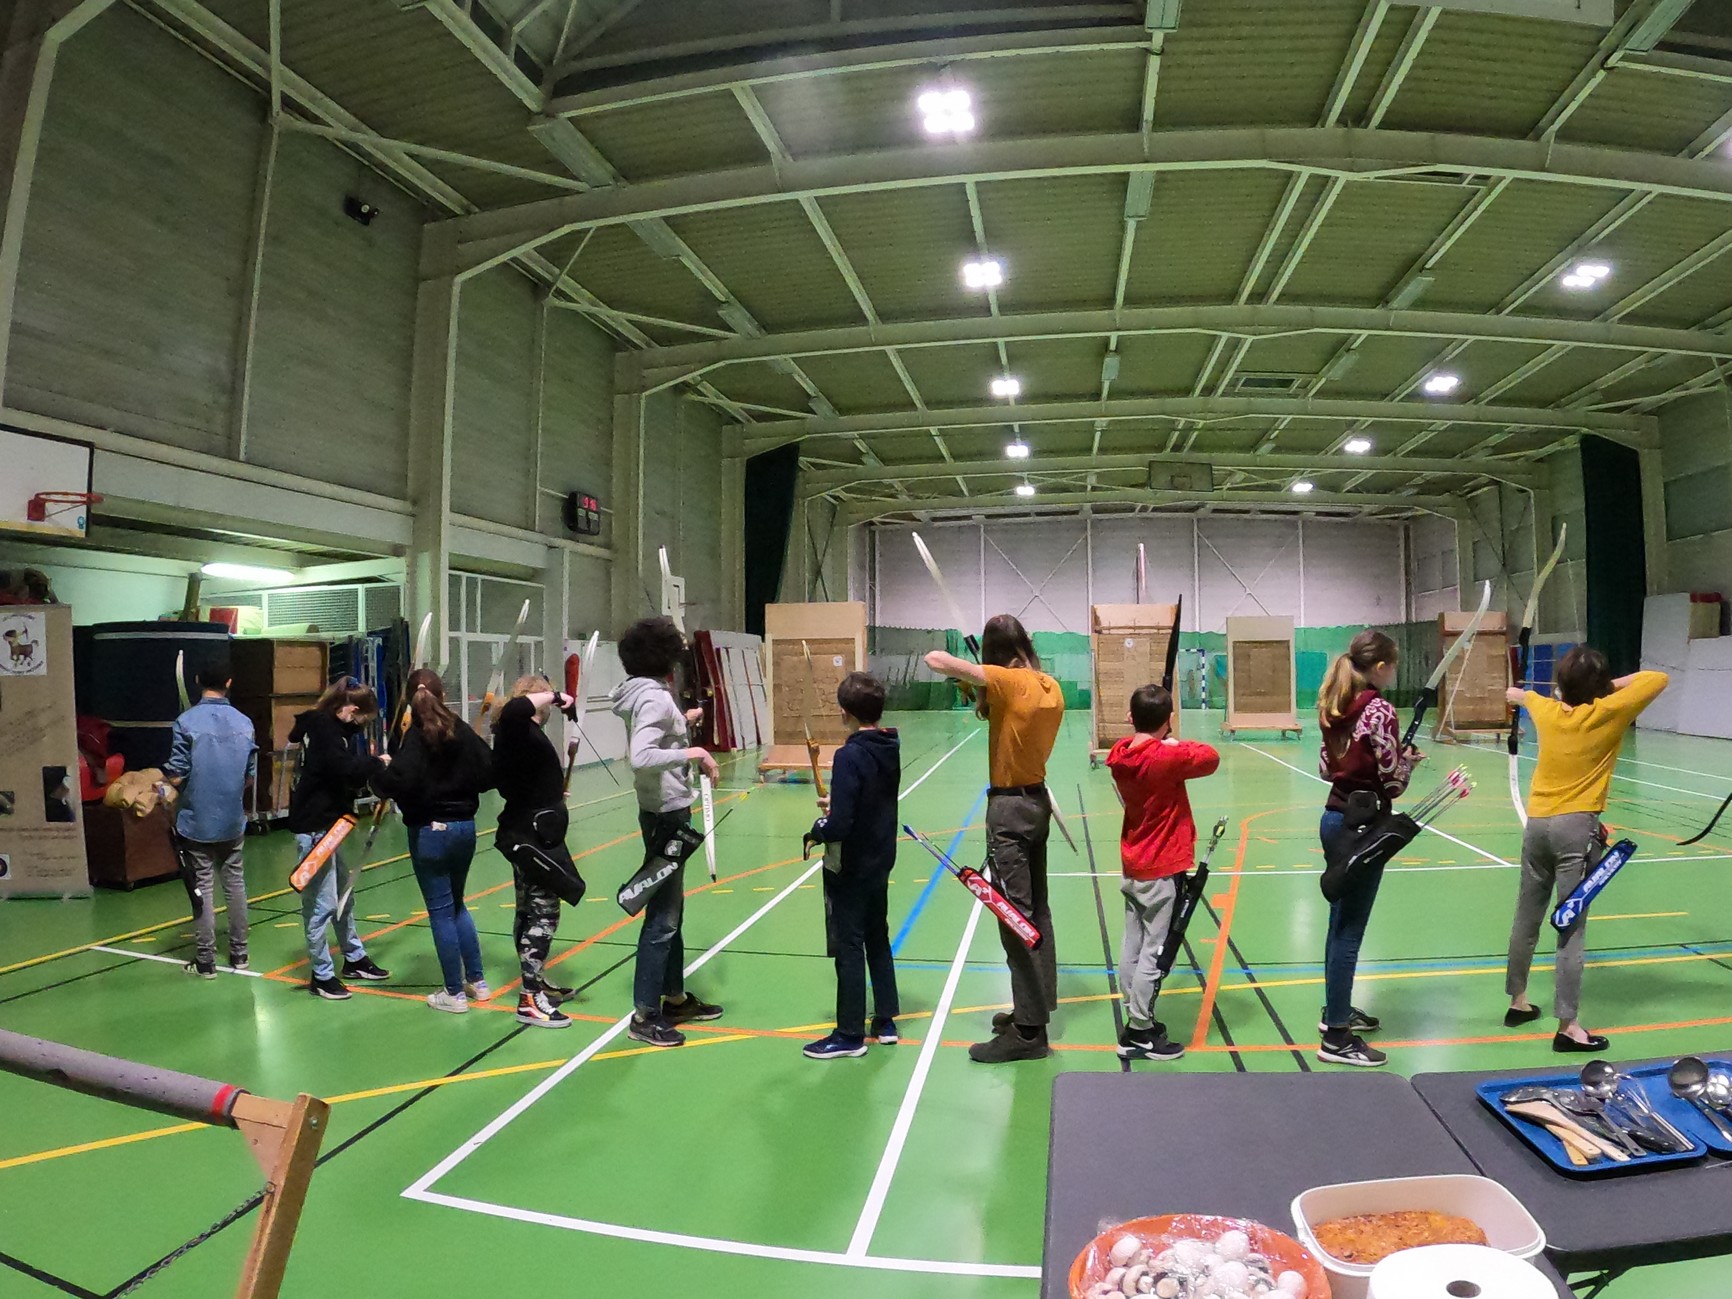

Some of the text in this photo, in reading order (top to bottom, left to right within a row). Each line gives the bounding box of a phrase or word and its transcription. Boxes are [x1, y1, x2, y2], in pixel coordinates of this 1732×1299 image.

[618, 862, 679, 904] AVALON
[1582, 850, 1620, 893] AVALON
[996, 901, 1036, 937] AVALON
